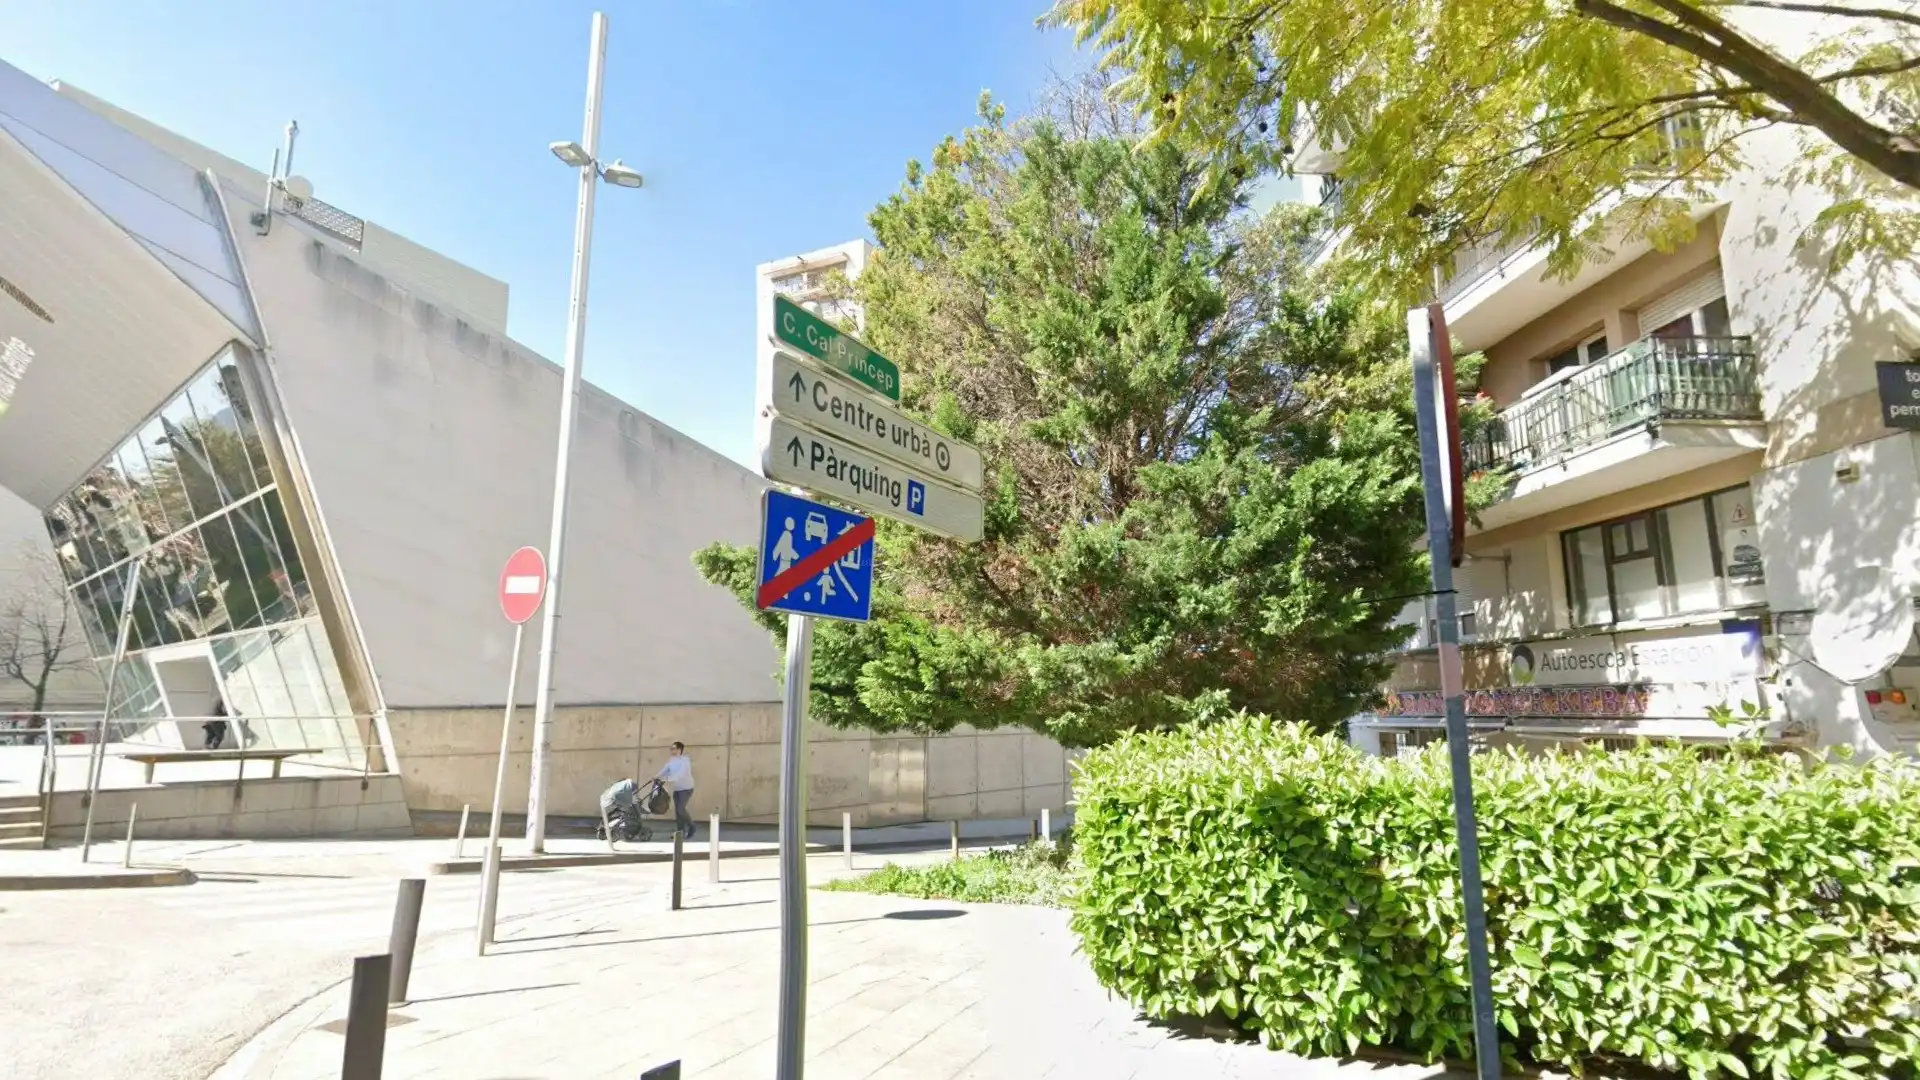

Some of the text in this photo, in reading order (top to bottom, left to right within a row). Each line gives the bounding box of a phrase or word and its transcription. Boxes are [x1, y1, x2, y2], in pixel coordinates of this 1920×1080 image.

[783, 311, 801, 338] C.
[806, 324, 832, 353] Cal
[812, 381, 931, 458] Centre urbà
[811, 441, 901, 507] Pàrquing
[1540, 651, 1626, 672] Autoescoa
[1551, 685, 1654, 713] KEBA
